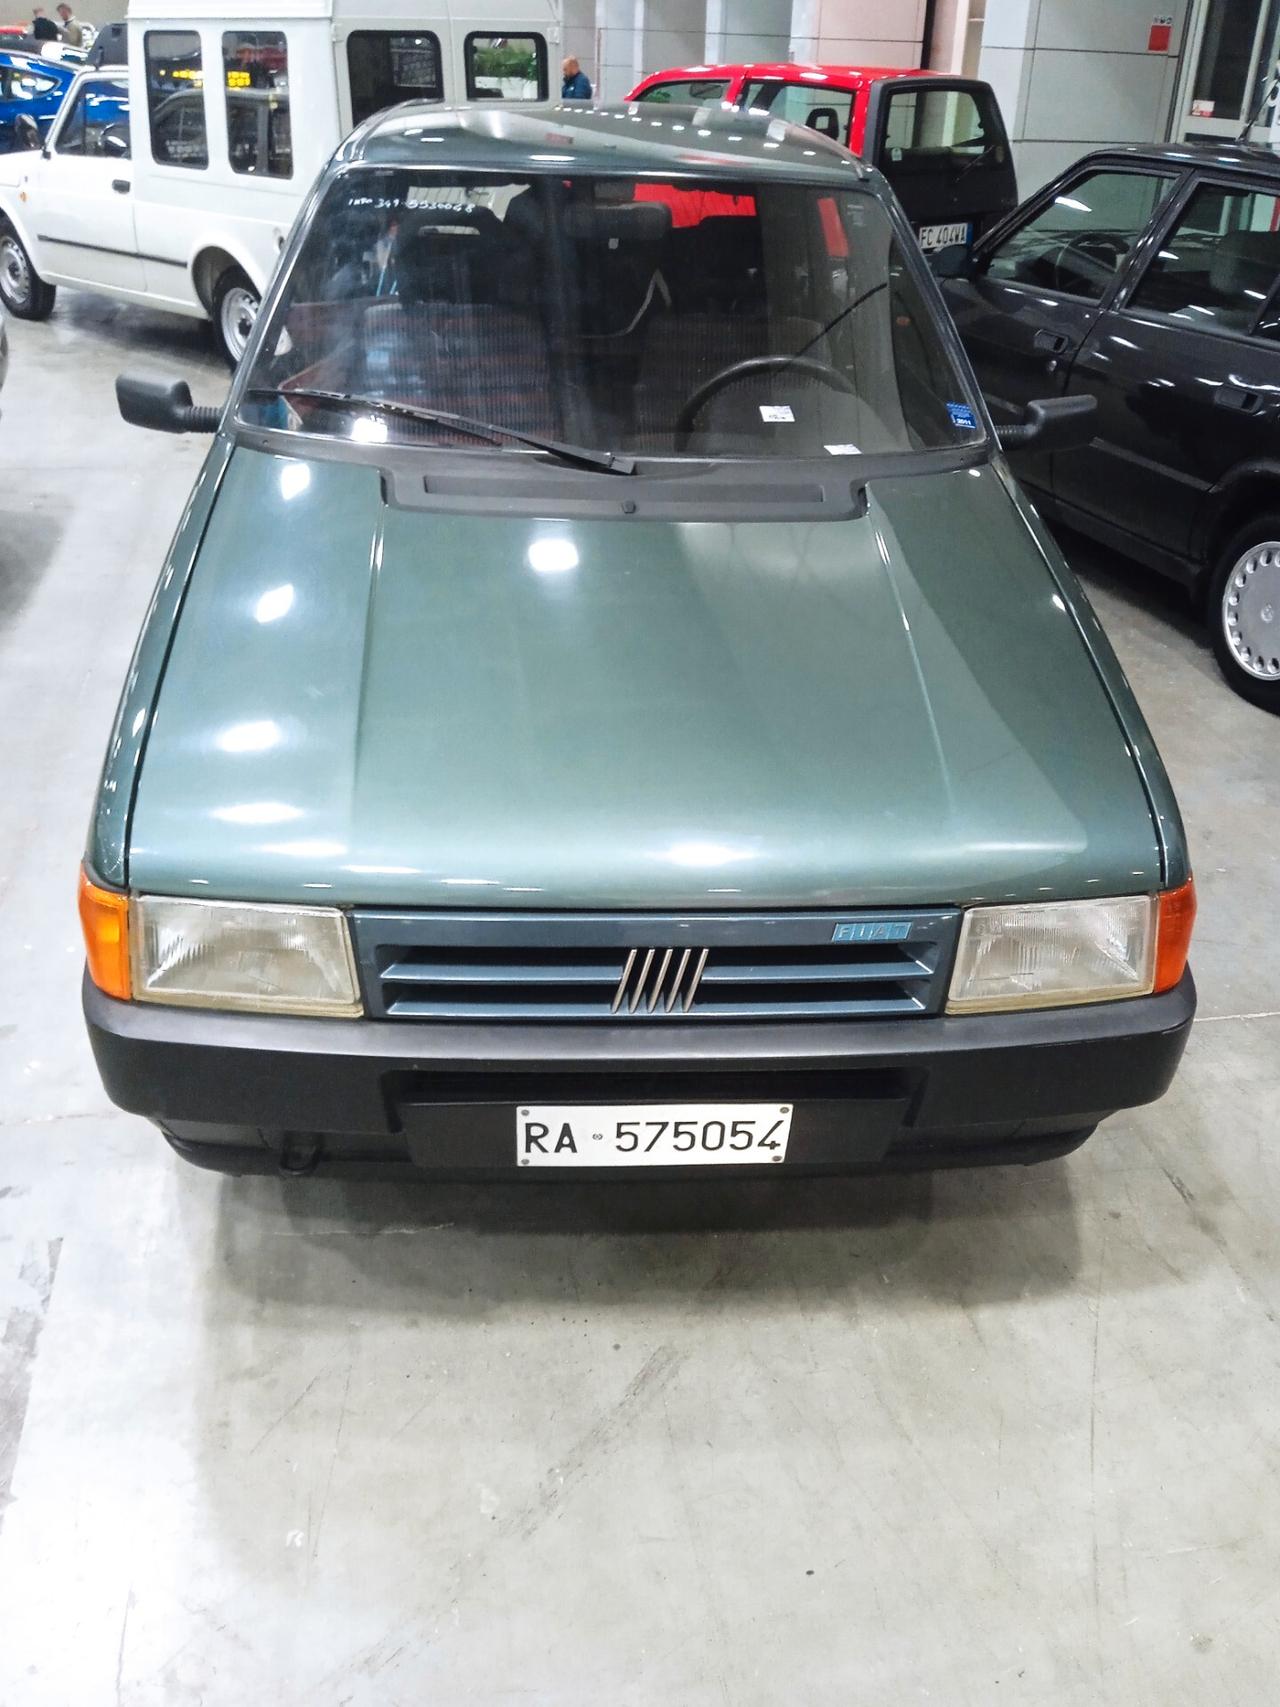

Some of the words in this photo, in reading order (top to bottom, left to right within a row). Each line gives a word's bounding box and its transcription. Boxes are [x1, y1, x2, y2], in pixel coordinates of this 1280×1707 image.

[836, 924, 907, 939] FIAT
[524, 1122, 578, 1154] RA
[615, 1120, 784, 1153] 575054
